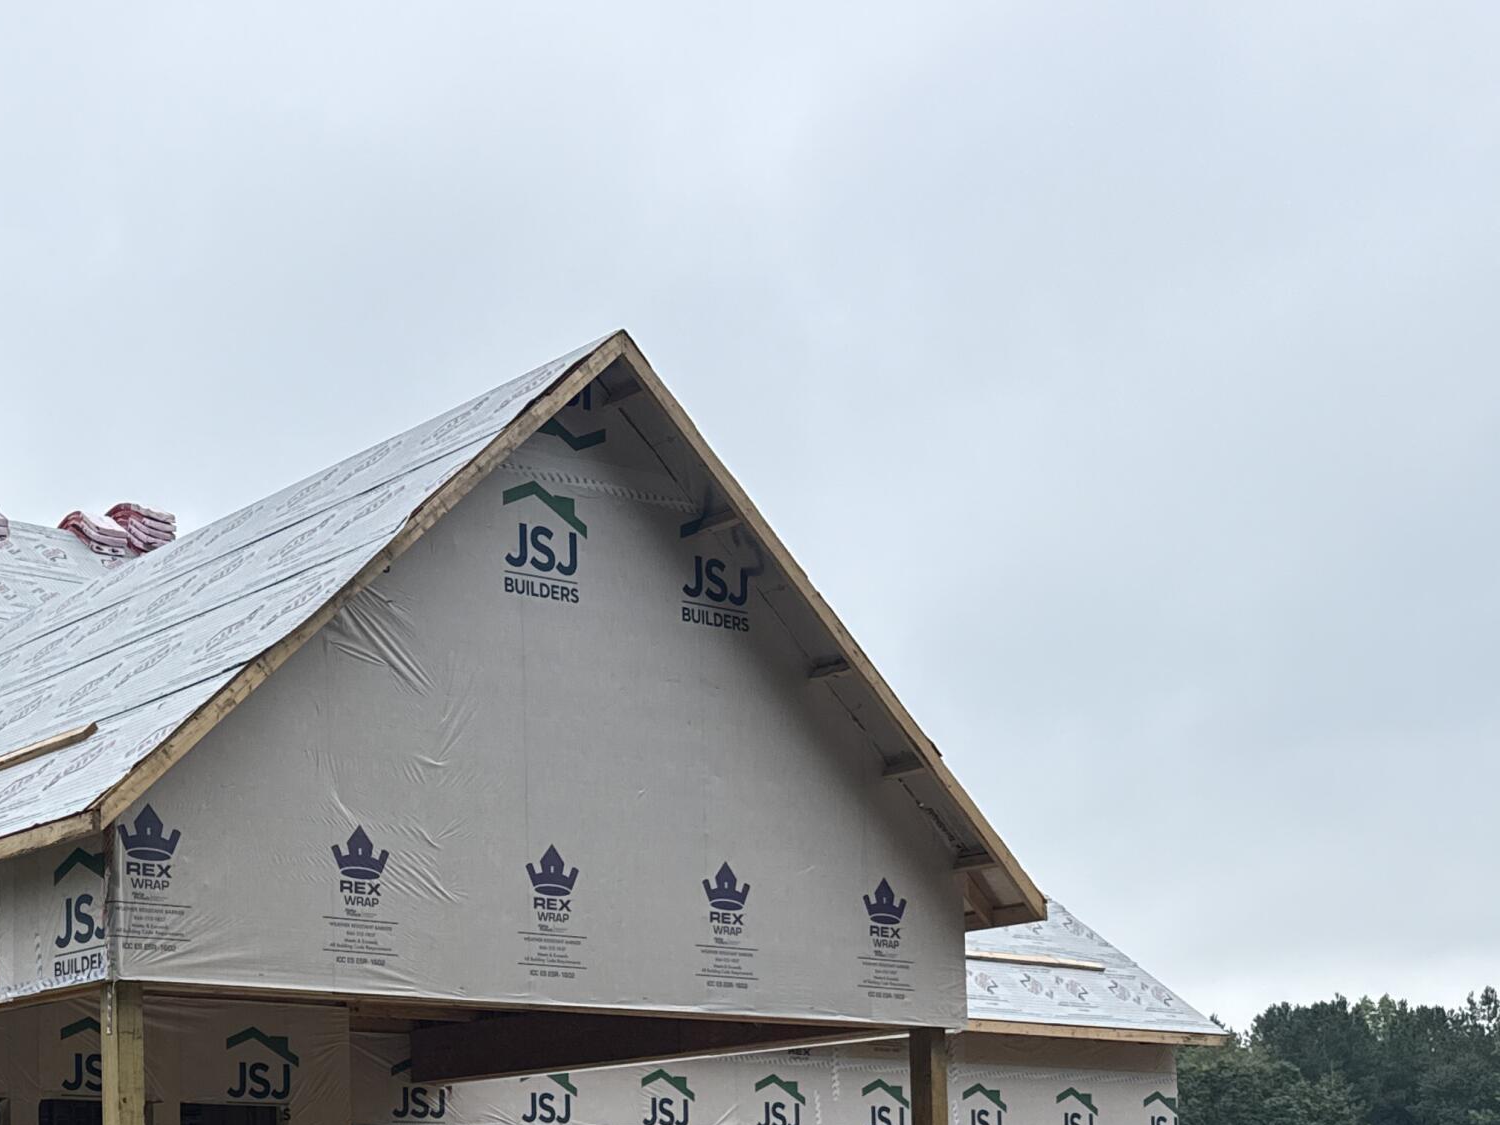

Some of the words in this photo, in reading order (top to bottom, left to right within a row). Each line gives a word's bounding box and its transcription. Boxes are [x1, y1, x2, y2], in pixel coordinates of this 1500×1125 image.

[505, 523, 578, 576] JSJ
[682, 555, 749, 607] JSJ
[504, 577, 579, 604] BUILDERS
[681, 606, 749, 632] BUILDERS
[126, 862, 172, 878] REX
[131, 878, 170, 890] WRAP
[340, 880, 381, 896] REX
[344, 895, 380, 907] WRAP
[533, 897, 572, 912] REX
[537, 912, 570, 923] WRAP
[710, 911, 744, 926] REX
[713, 925, 742, 936] WRAP
[870, 925, 901, 939] REX
[872, 938, 900, 949] WRAP
[54, 951, 102, 977] BUILDE
[62, 1053, 102, 1091] JS
[227, 1062, 290, 1100] JSJ
[392, 1087, 445, 1118] JSJ
[522, 1092, 570, 1124] JSJ
